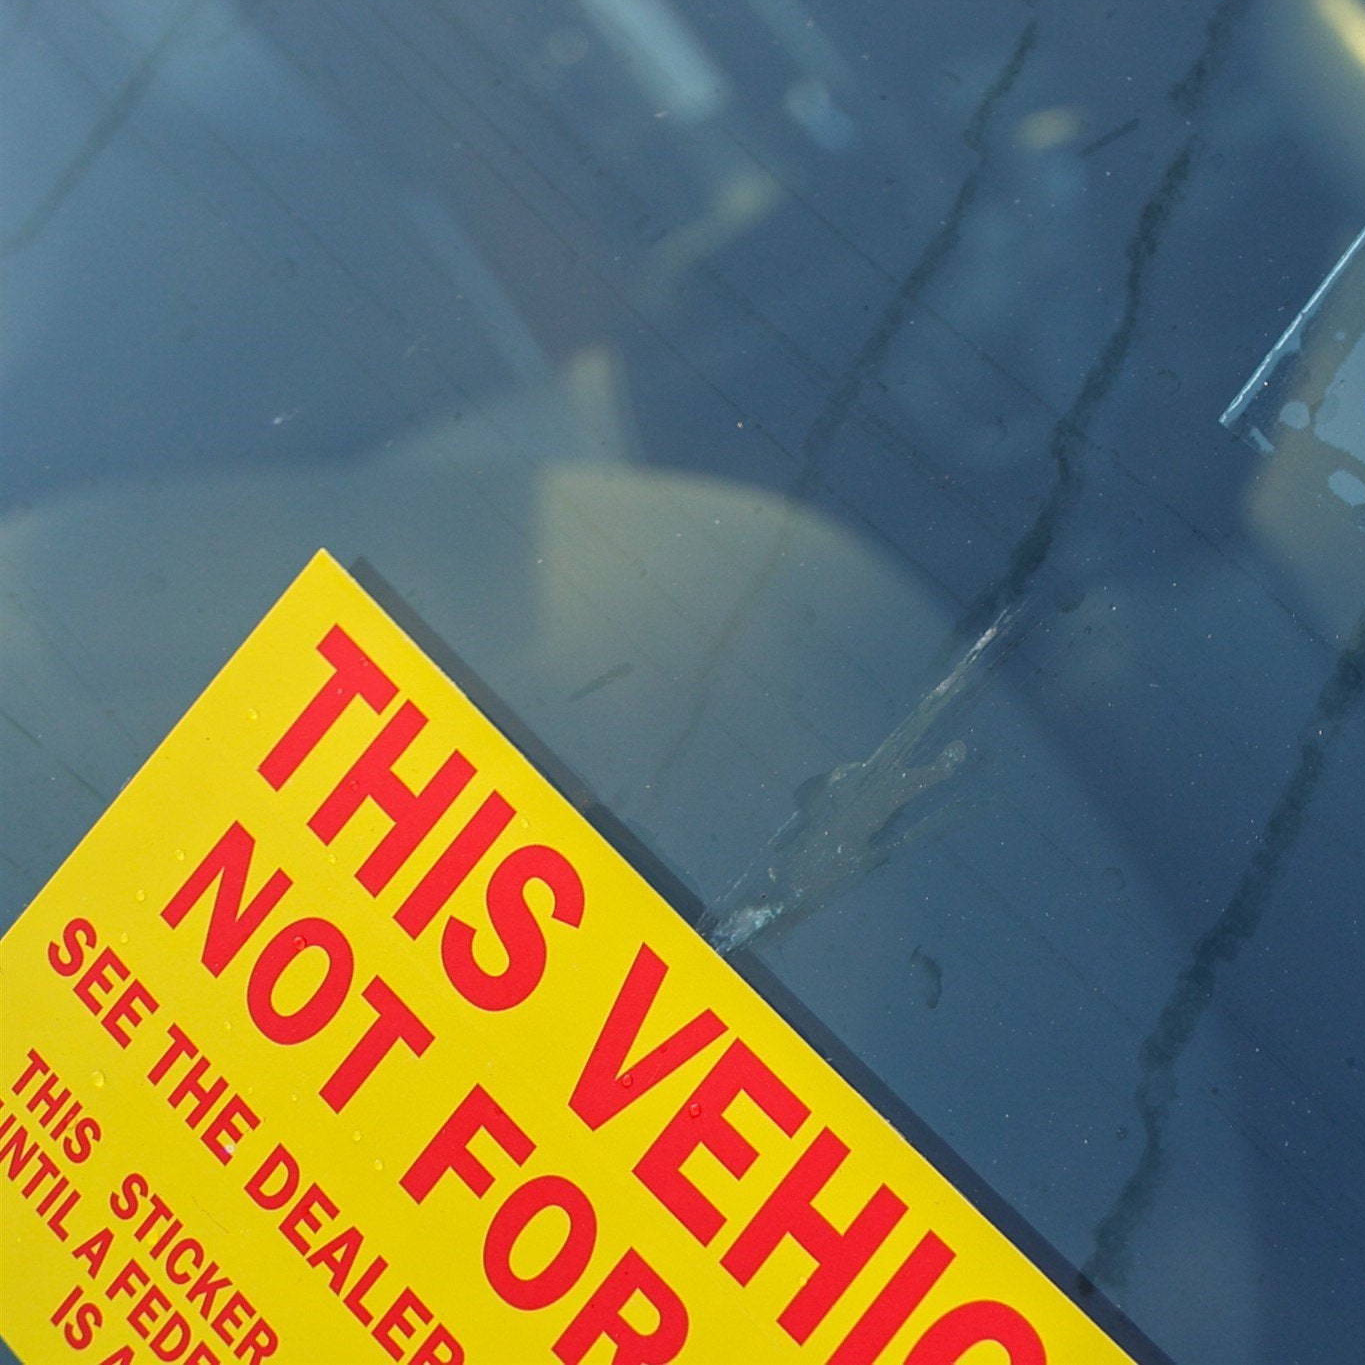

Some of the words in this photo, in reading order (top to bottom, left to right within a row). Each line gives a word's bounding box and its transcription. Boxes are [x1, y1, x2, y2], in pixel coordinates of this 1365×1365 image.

[257, 623, 586, 1012] THIS
[47, 917, 160, 1050] SEE
[146, 1022, 262, 1167] THE
[160, 820, 436, 1115] NOT
[398, 1082, 690, 1365] FOR
[11, 1047, 102, 1164] THIS
[109, 1172, 280, 1365] STICKER
[50, 1284, 104, 1351] IS
[71, 1227, 115, 1281] A
